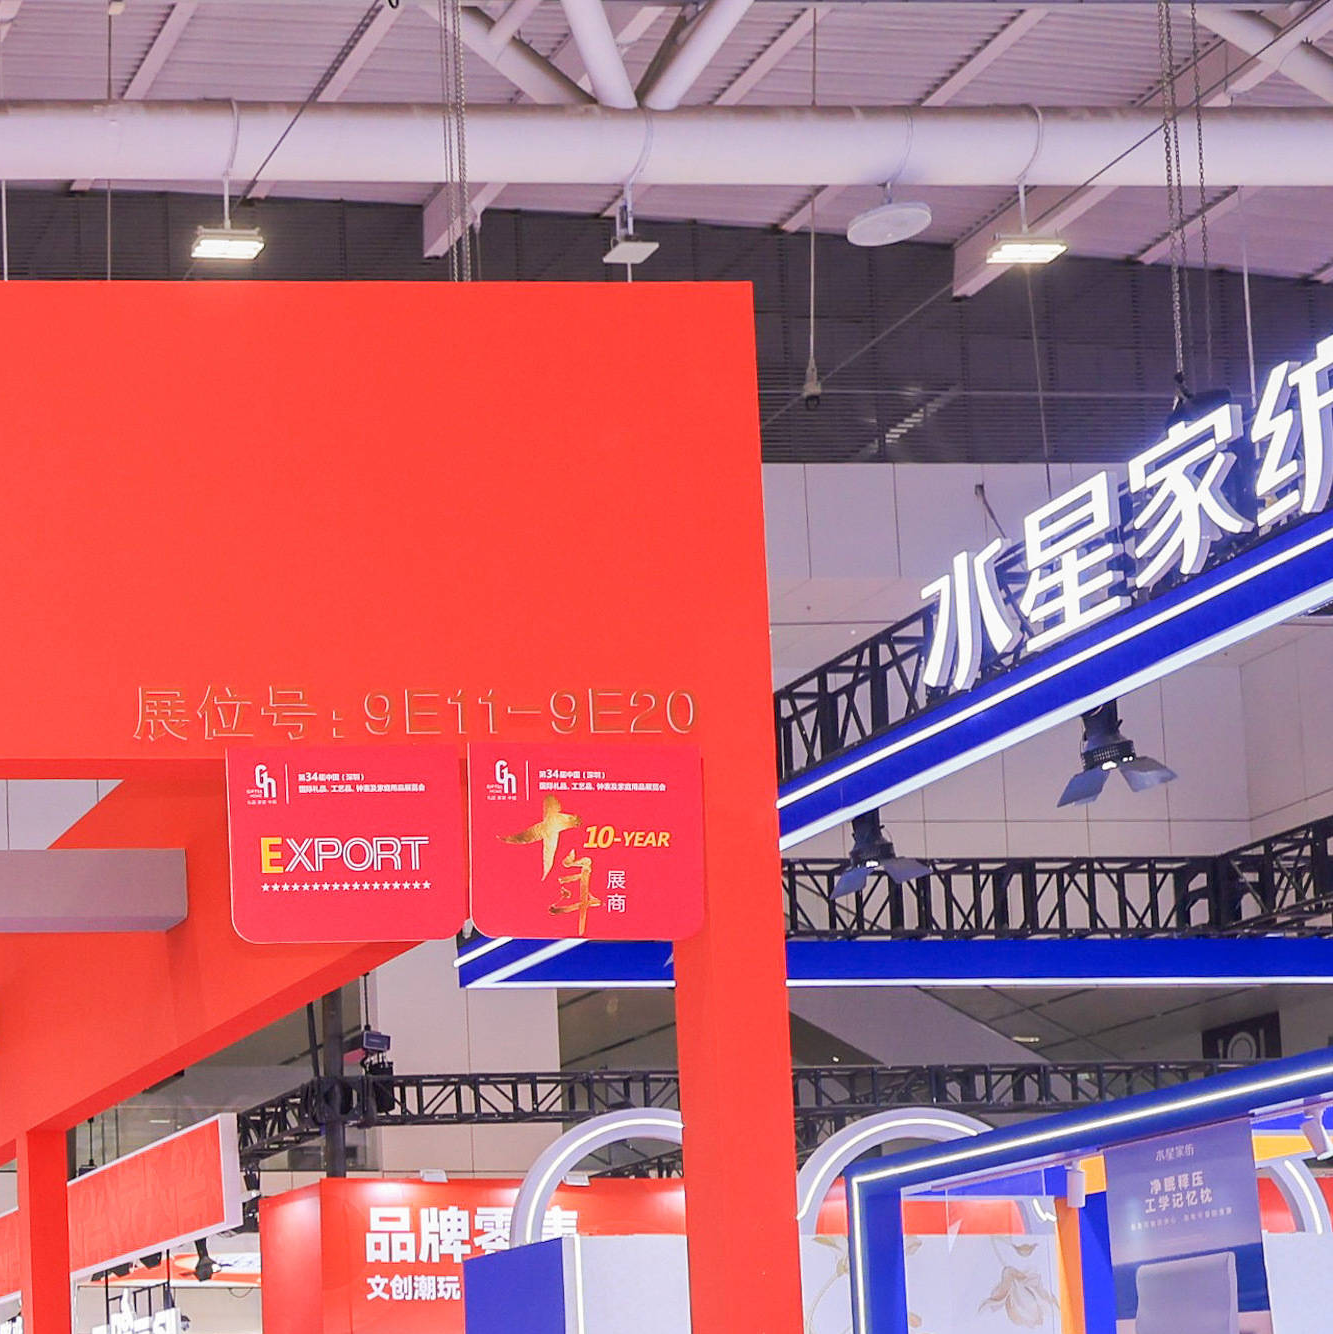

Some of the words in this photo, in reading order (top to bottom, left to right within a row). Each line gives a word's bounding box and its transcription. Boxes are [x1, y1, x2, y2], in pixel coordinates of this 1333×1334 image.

[583, 826, 670, 849] 10-YEAR
[260, 836, 430, 874] EXPORT
[606, 870, 626, 913] 展商
[366, 1274, 462, 1301] 文创潮玩
